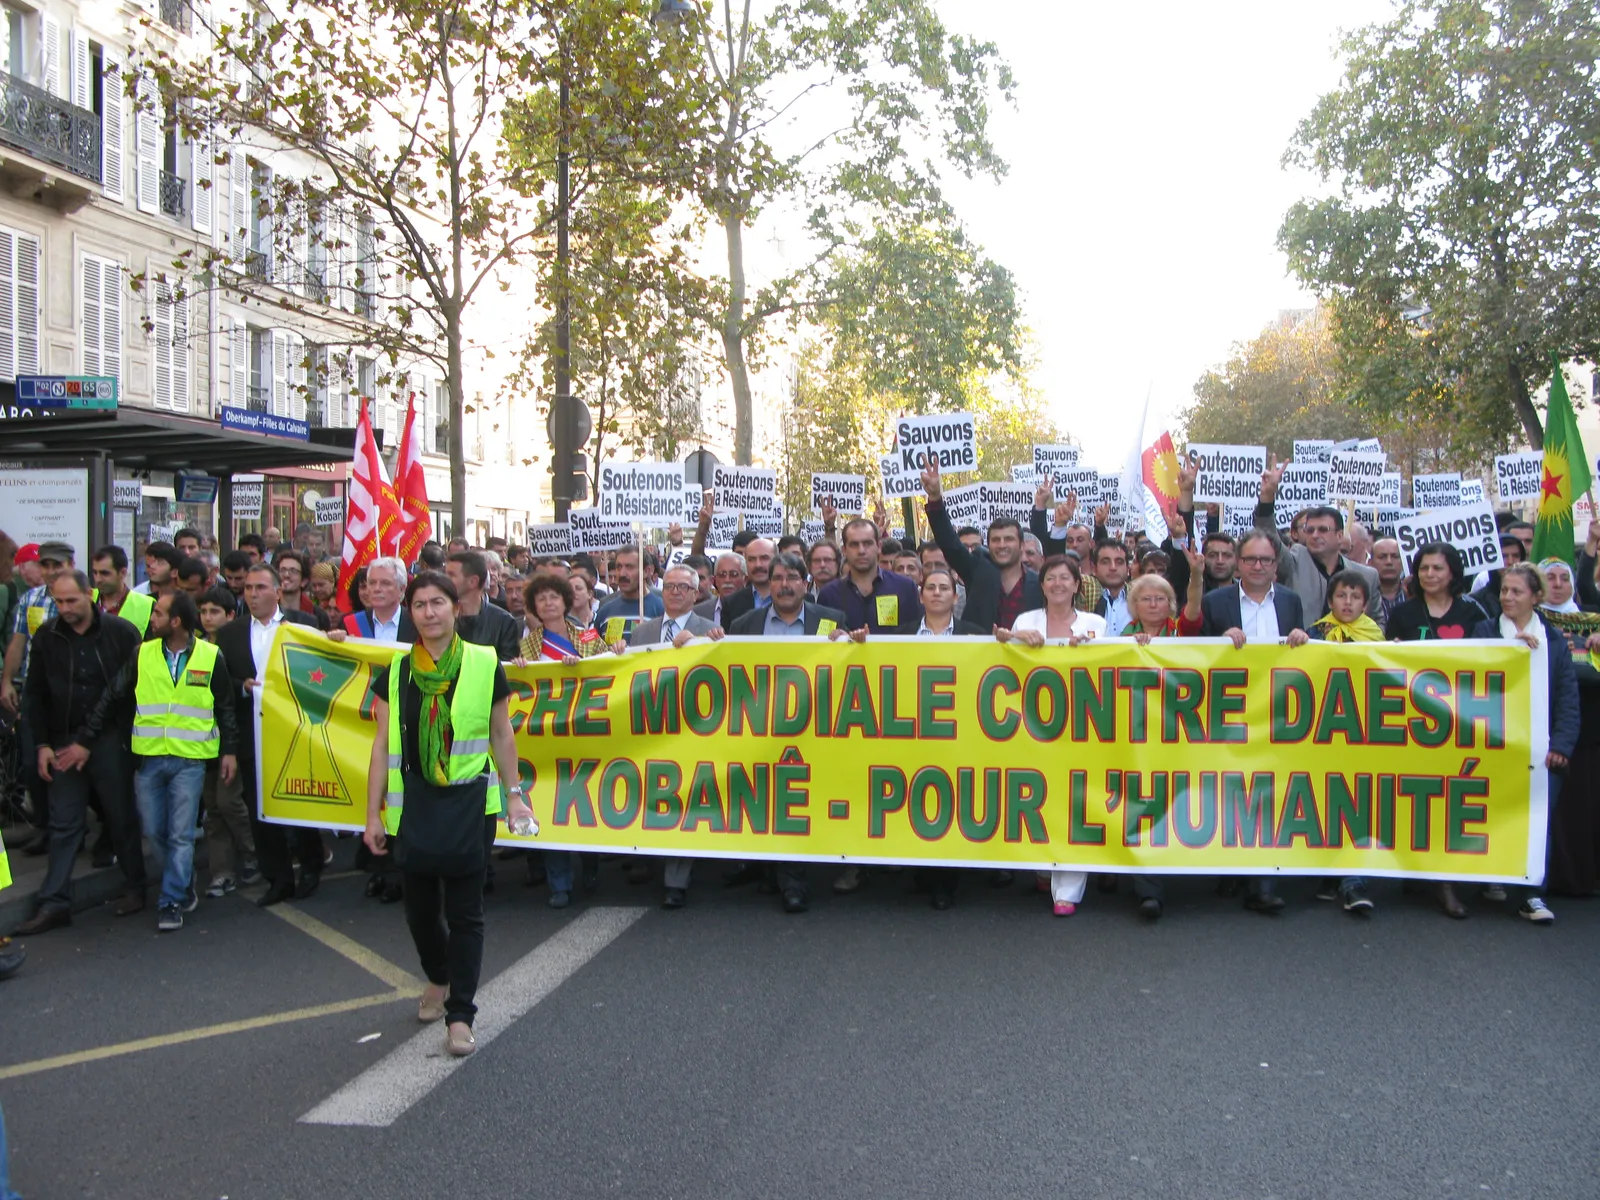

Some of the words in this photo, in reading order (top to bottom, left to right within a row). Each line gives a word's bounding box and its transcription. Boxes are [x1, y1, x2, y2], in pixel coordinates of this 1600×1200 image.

[278, 420, 286, 431] du
[286, 421, 307, 436] Calvaire
[898, 422, 973, 447] Sauvons
[902, 441, 974, 472] Kobanê
[1034, 447, 1078, 461] Sauvons
[1189, 449, 1263, 474] Soutenons
[1330, 455, 1383, 477] Soutenons
[602, 468, 682, 491] Soutenons
[714, 469, 774, 491] Soutenons
[812, 476, 864, 494] Sauvons
[1053, 470, 1098, 484] Sauvons
[1200, 473, 1262, 498] Résistance
[1280, 470, 1328, 484] auvons
[1327, 475, 1335, 494] la
[1336, 475, 1381, 498] Résistance
[1414, 478, 1460, 493] Soutenons
[114, 486, 140, 497] enons
[980, 486, 1033, 505] Soutenons
[1055, 482, 1099, 499] Kobanê
[1275, 484, 1326, 501] Kobanê
[1499, 478, 1508, 497] la
[601, 492, 612, 516] la
[615, 492, 683, 517] Résistance
[713, 488, 721, 507] la
[722, 488, 773, 512] Résistance
[1423, 493, 1461, 508] Résistance
[979, 504, 987, 522] la
[571, 532, 581, 549] la
[582, 530, 632, 548] Résistance
[1398, 513, 1494, 552] Sauvons
[629, 664, 958, 740] MONDIALE
[976, 664, 1249, 745] CONTRE
[1270, 667, 1506, 750] DAESH
[285, 777, 339, 800] URGENCE
[552, 745, 811, 836] KOBANÊ
[867, 765, 1050, 843] POUR
[1068, 757, 1491, 855] L'HUMANITÉ
